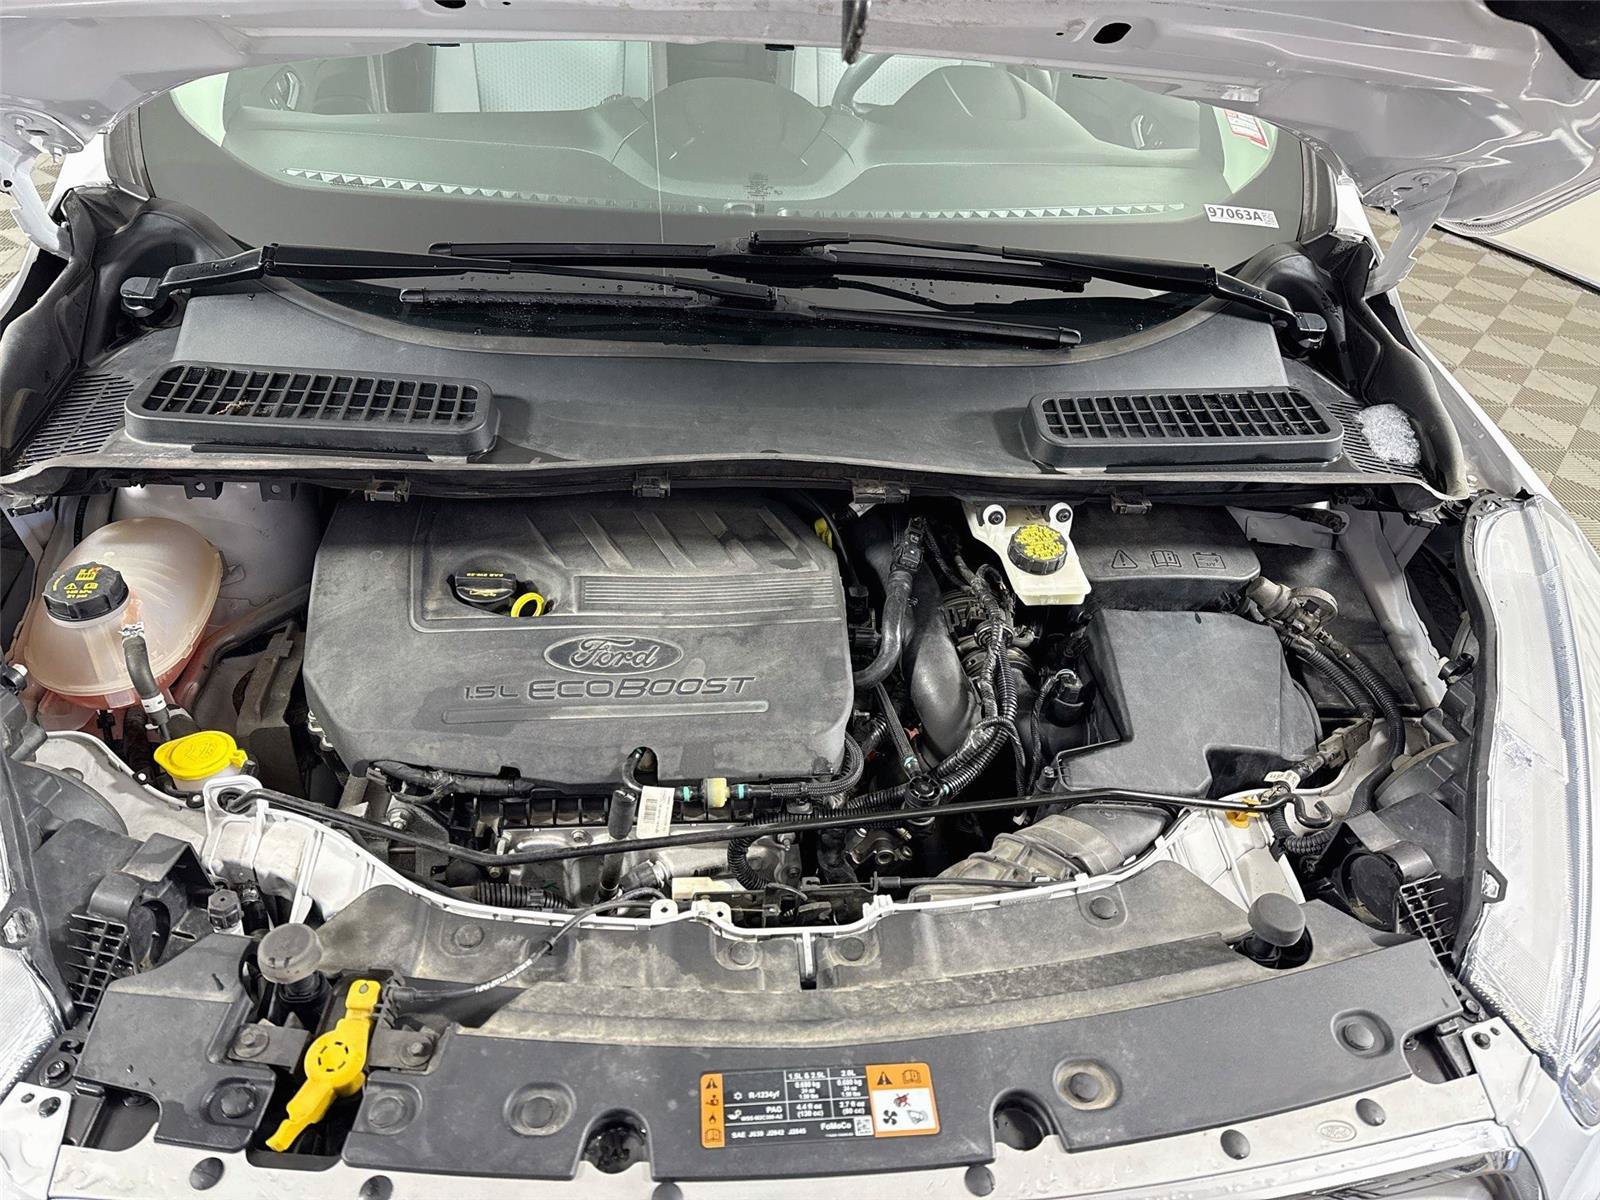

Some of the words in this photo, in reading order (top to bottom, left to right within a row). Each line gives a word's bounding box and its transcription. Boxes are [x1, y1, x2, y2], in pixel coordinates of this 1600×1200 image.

[1208, 206, 1263, 221] 97063A
[569, 638, 660, 668] Ford
[464, 686, 518, 700] 1.5L
[528, 677, 756, 700] ECOBOOST
[820, 1121, 852, 1131] FoMoCo
[731, 1131, 746, 1139] SAE
